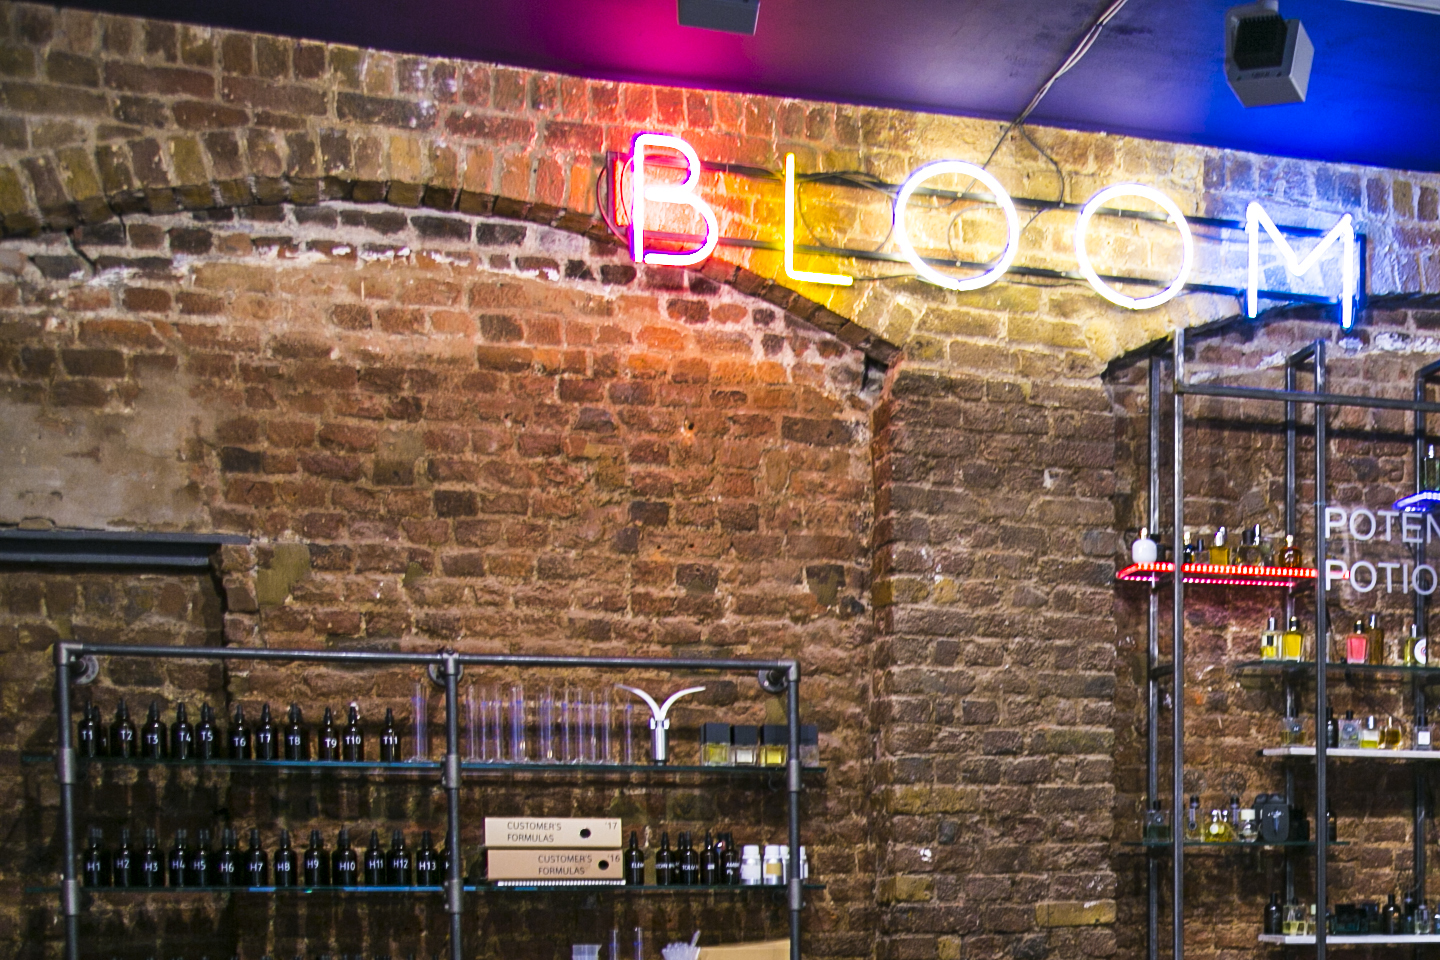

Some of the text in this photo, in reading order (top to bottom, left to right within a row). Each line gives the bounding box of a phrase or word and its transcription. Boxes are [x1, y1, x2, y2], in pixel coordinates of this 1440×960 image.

[633, 133, 1355, 330] BLOOM
[82, 730, 93, 741] T1
[121, 730, 133, 741] T2
[147, 734, 159, 745] T3
[179, 732, 191, 743] T4
[201, 731, 213, 742] T5
[260, 733, 271, 744] T7
[289, 735, 300, 746] T8
[345, 735, 361, 745] T10
[383, 735, 398, 745] T11
[234, 737, 246, 747] T6
[325, 738, 337, 749] T9
[507, 822, 562, 831] CUSTOMER'S
[605, 822, 618, 830] '17
[507, 833, 554, 842] FORMULAS
[117, 859, 130, 869] H2
[307, 858, 319, 869] H9
[393, 859, 408, 869] H12
[538, 855, 592, 863] CUSTOMER'S
[87, 862, 100, 872] H1
[145, 862, 158, 872] H3
[172, 860, 185, 870] H4
[194, 860, 206, 870] H5
[221, 862, 234, 873] H6
[250, 862, 263, 872] H7
[277, 862, 290, 872] H8
[369, 860, 384, 869] H11
[419, 861, 436, 871] H13
[538, 867, 585, 876] FORMULAS
